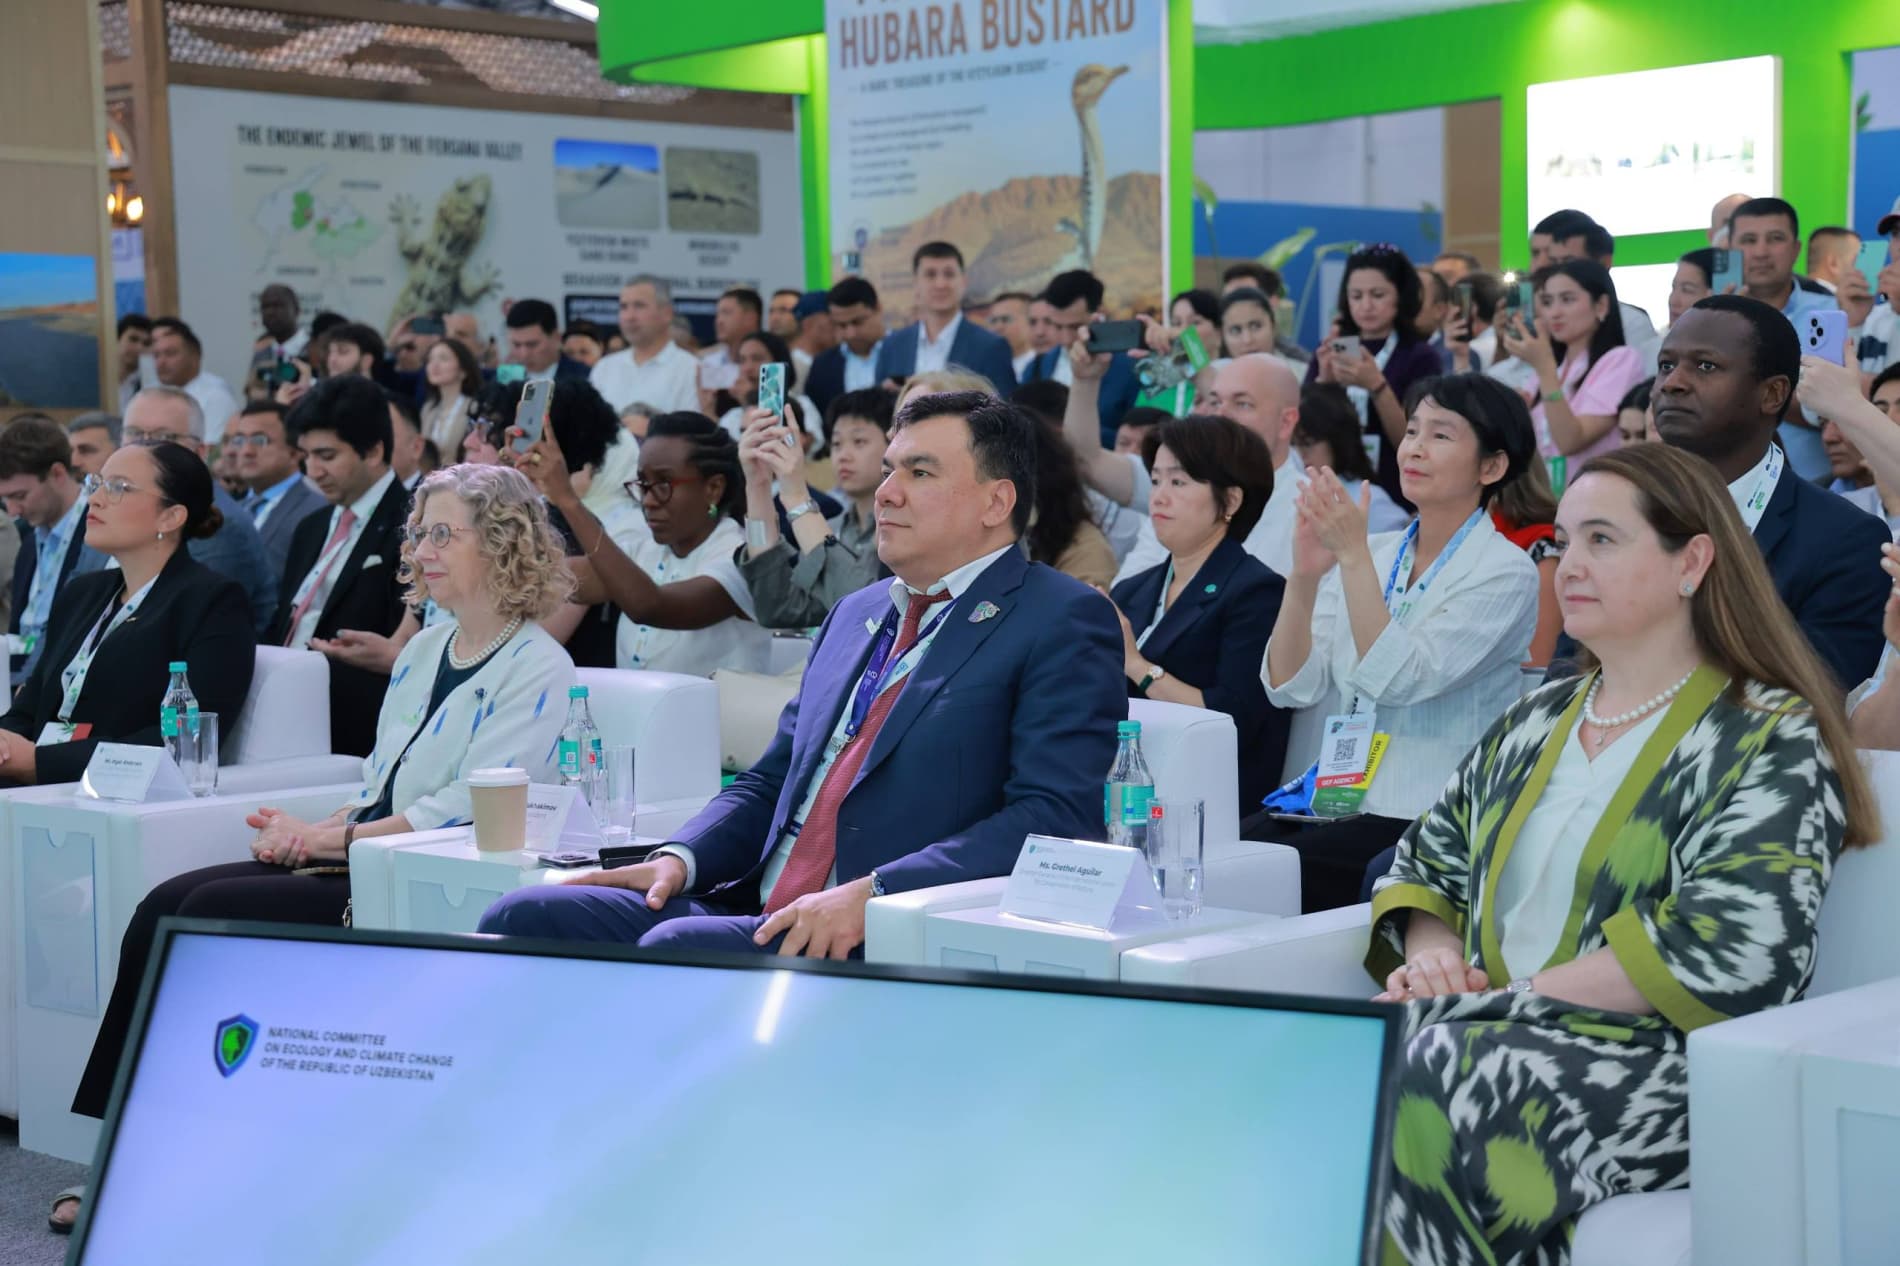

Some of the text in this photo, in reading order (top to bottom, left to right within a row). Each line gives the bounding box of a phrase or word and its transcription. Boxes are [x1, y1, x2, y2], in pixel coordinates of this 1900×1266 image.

[840, 0, 1136, 69] HUBARA BUSTARD
[238, 124, 262, 145] THE
[266, 126, 325, 149] ENDEMIC
[331, 130, 375, 152] JEWEL
[379, 133, 395, 152] OF
[400, 134, 423, 155] THE
[1051, 863, 1078, 873] Grethel
[1077, 866, 1104, 877] Aguilar
[268, 1027, 387, 1046] NATIONAL COMMITTEE
[264, 1042, 454, 1067] ON ECOLOGY AND CLIMATE CHANGE
[260, 1057, 435, 1081] OF THE REPUBLIC OF UZBEKISTAN
